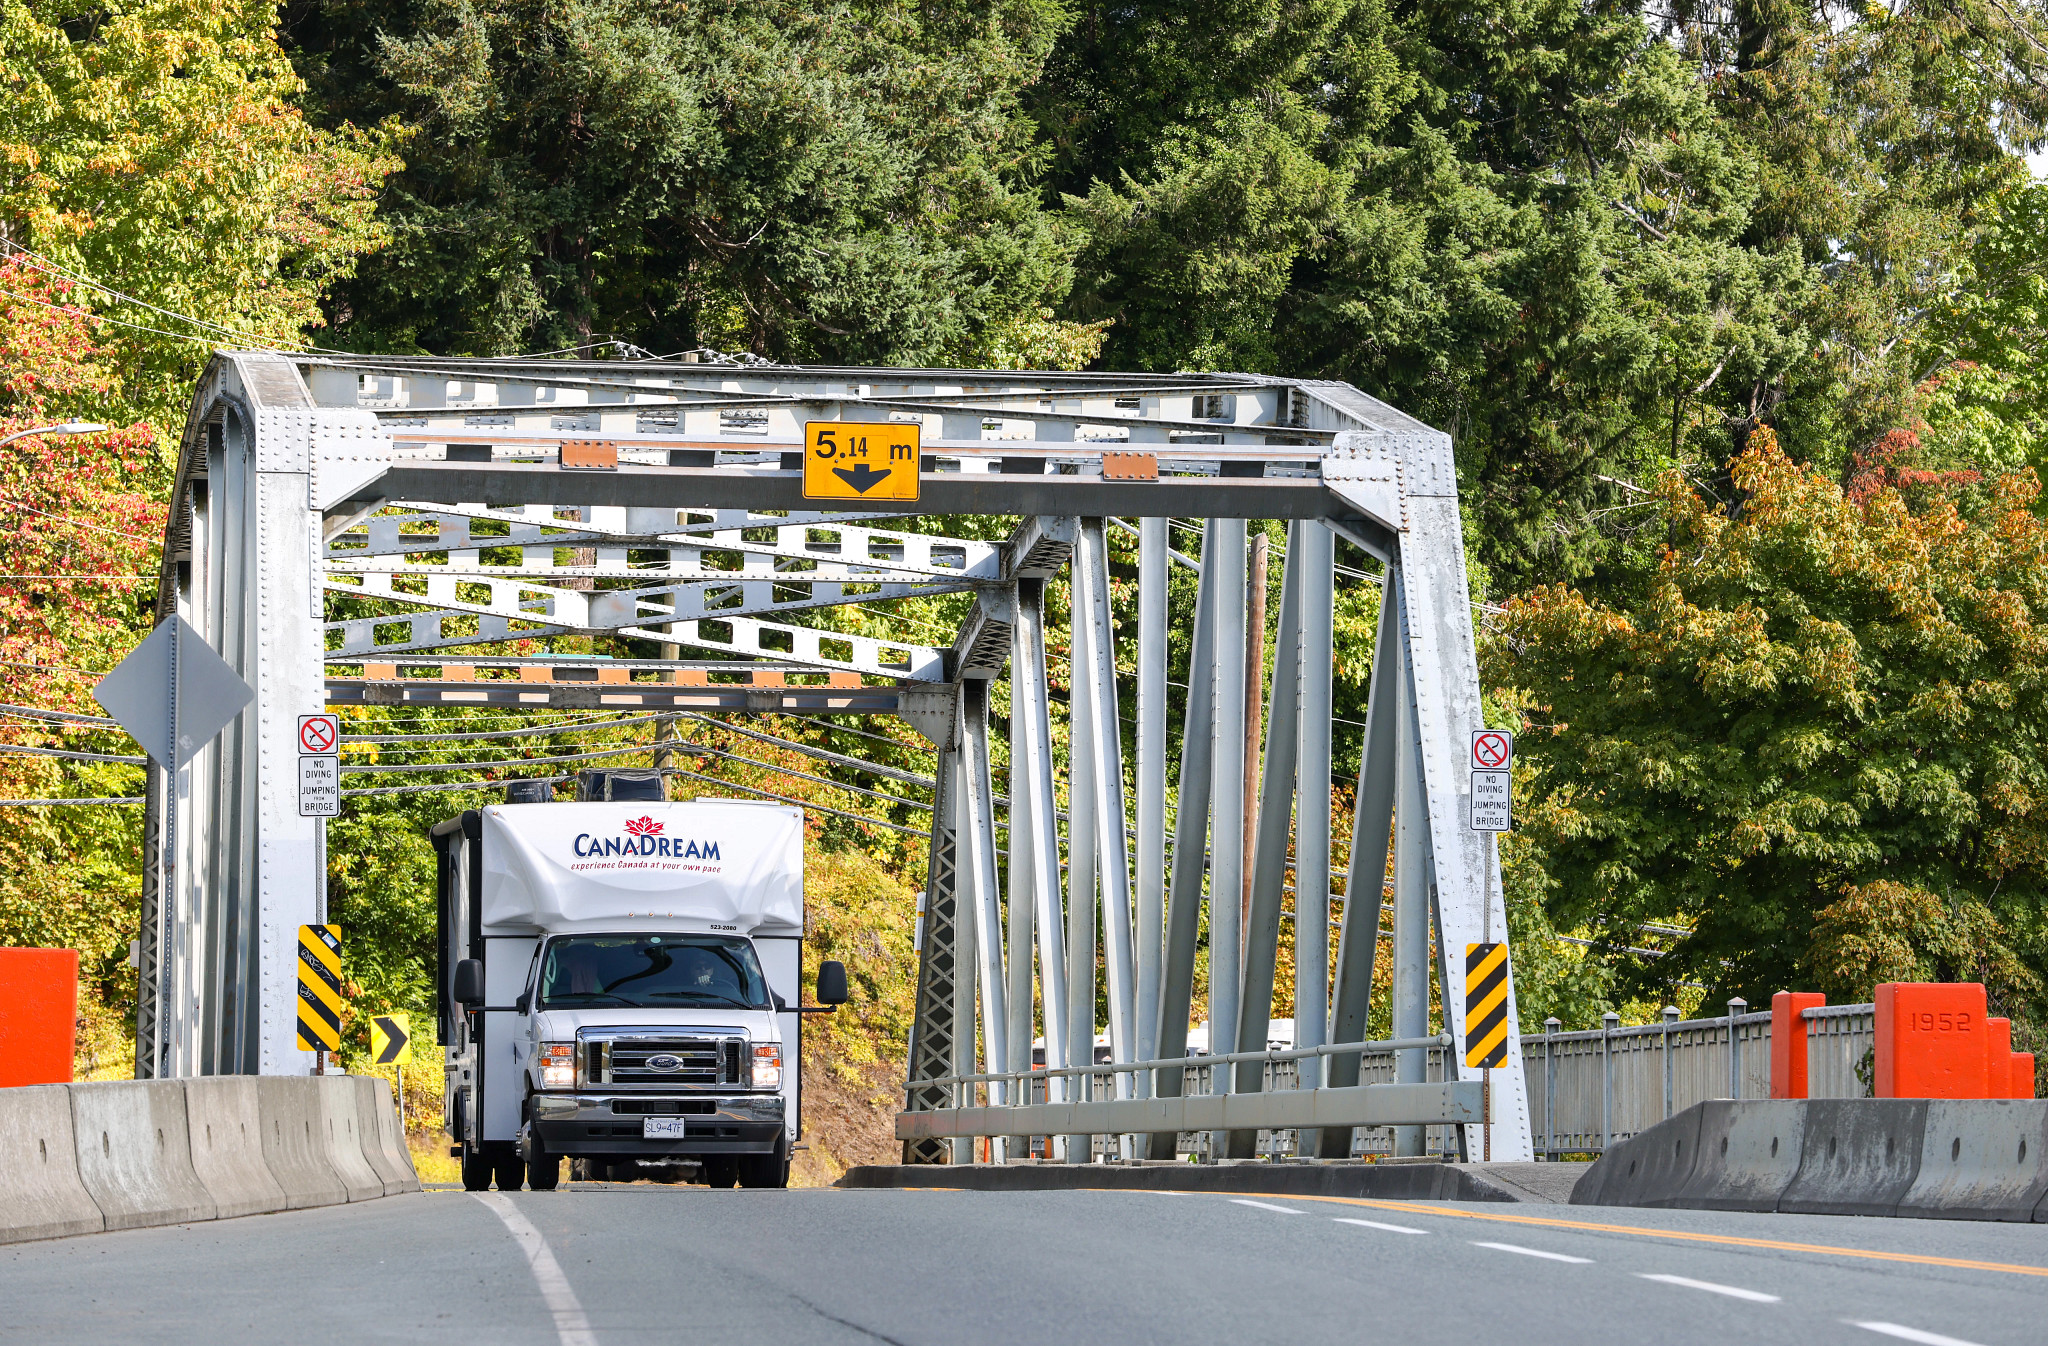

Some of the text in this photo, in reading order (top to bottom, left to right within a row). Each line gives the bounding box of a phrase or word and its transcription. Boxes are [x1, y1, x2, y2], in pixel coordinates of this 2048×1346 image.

[816, 431, 912, 460] 5.14 m
[313, 760, 325, 768] NO
[305, 770, 332, 779] DIVING
[1485, 775, 1497, 784] NO
[301, 786, 336, 795] JUMPING
[1477, 785, 1503, 794] DIVING
[304, 802, 334, 811] BRIDGE
[1473, 801, 1507, 810] JUMPING
[1475, 816, 1504, 826] BRIDGE
[570, 860, 722, 874] experience Canada at your own pace
[1911, 1012, 1970, 1032] 1952
